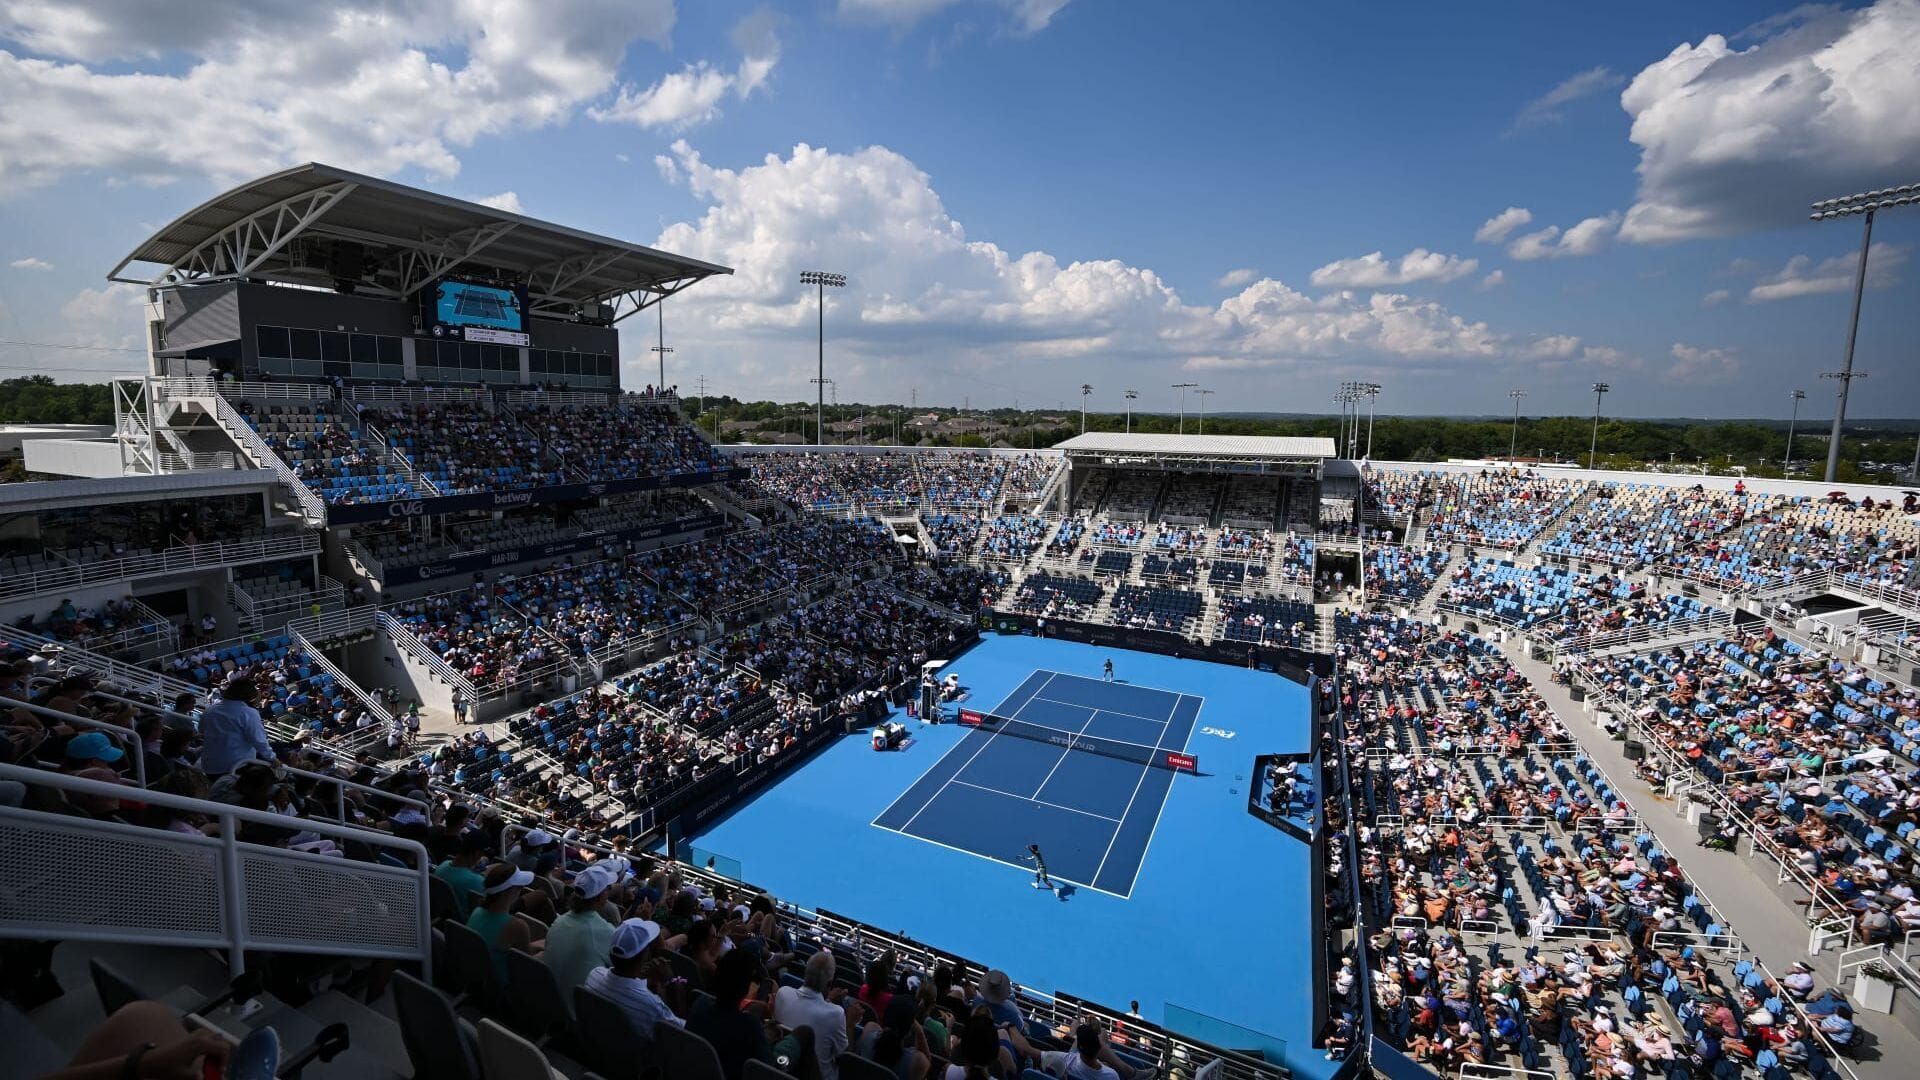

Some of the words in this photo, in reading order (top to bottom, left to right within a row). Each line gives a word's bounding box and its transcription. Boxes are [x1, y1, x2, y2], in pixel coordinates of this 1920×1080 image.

[494, 491, 533, 505] betway
[388, 501, 426, 517] CVG
[1168, 756, 1193, 767] Emirates
